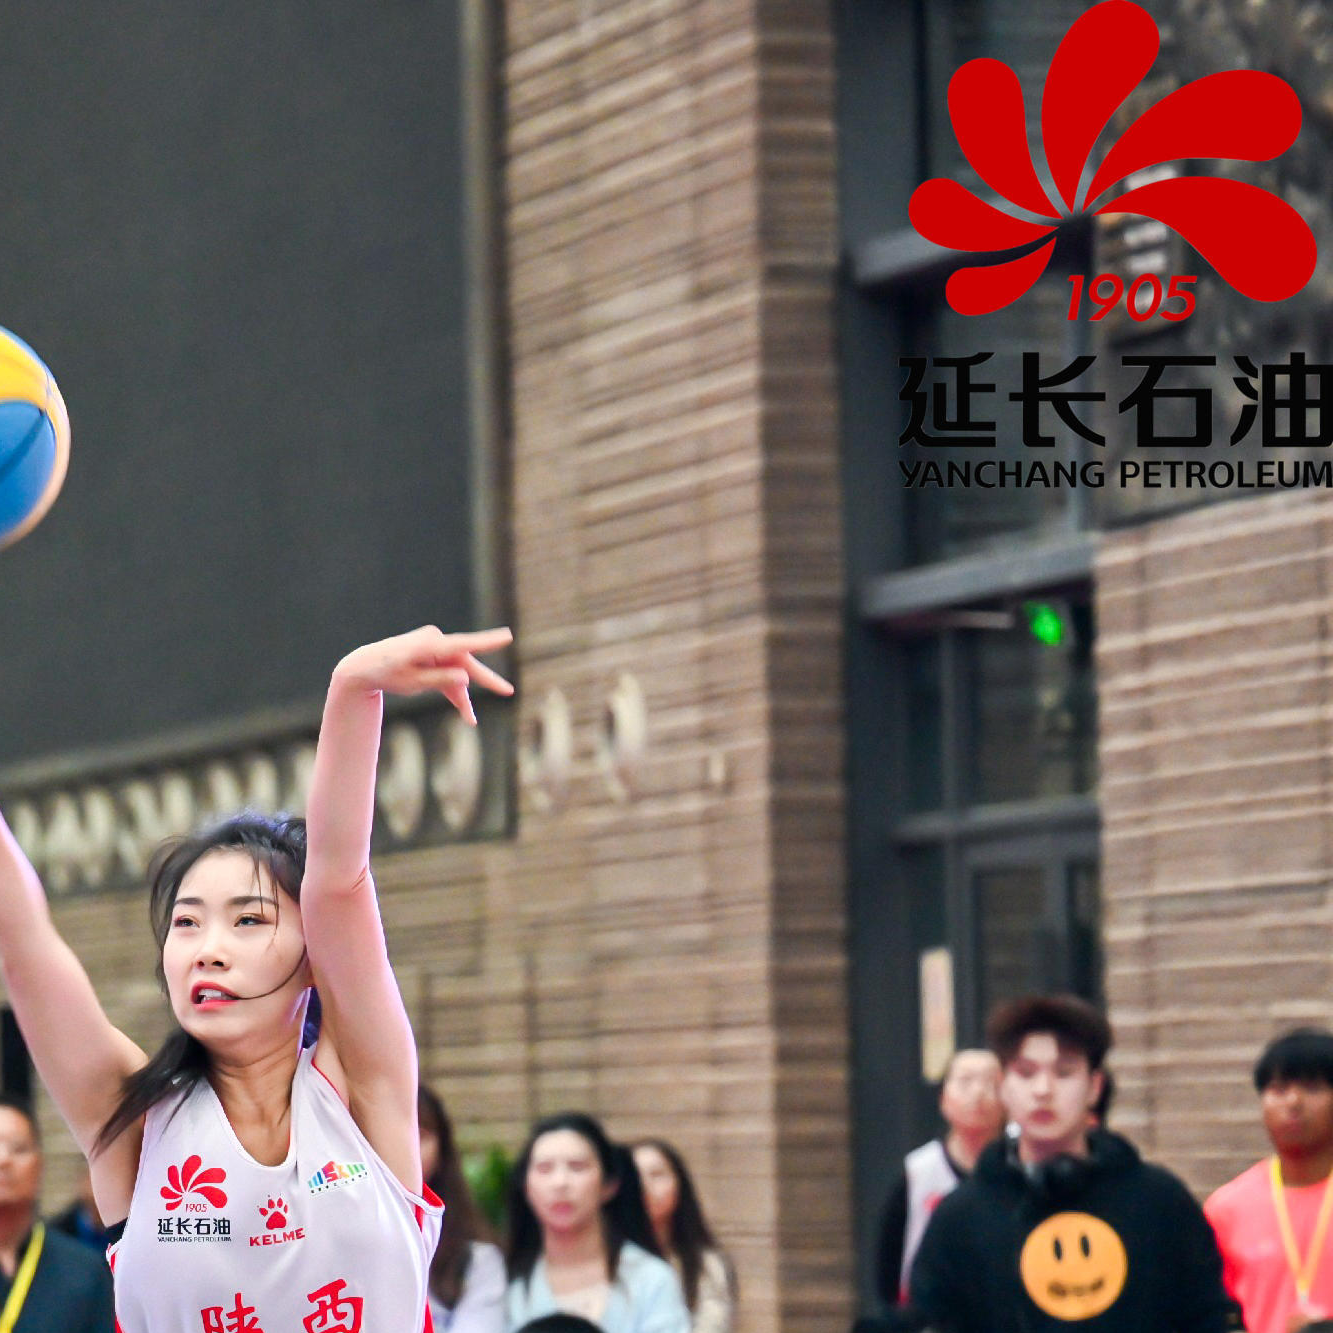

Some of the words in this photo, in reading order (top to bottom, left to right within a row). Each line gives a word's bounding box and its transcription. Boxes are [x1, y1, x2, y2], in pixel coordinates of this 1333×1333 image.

[184, 1203, 209, 1213] 1905
[157, 1217, 231, 1236] 延长石油
[249, 1227, 306, 1248] KELME
